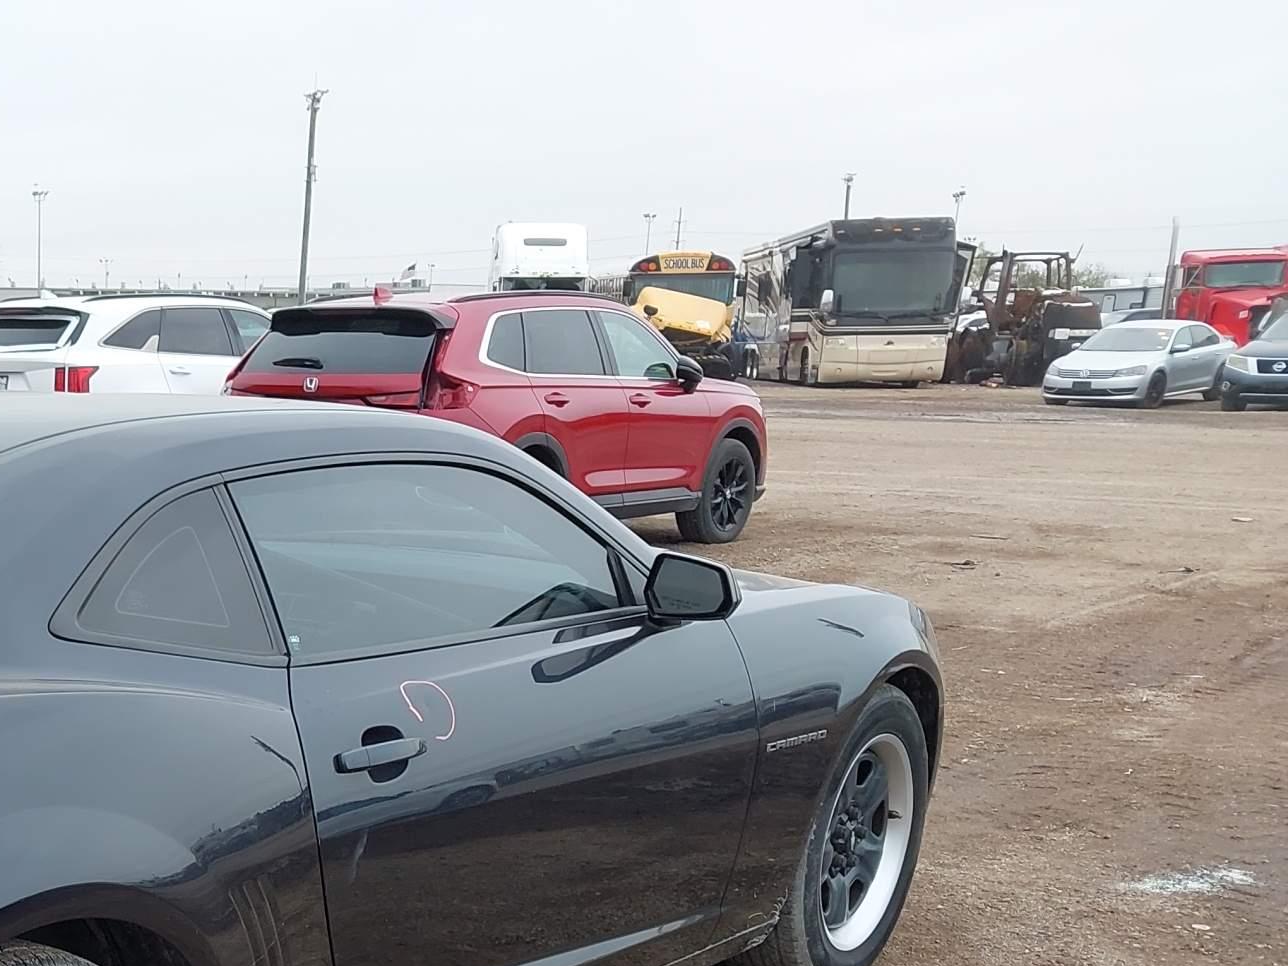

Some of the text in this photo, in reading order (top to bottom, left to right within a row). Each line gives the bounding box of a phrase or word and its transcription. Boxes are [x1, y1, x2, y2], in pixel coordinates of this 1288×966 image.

[664, 258, 705, 269] SCHOOL BUS
[766, 729, 828, 752] CAMARO
